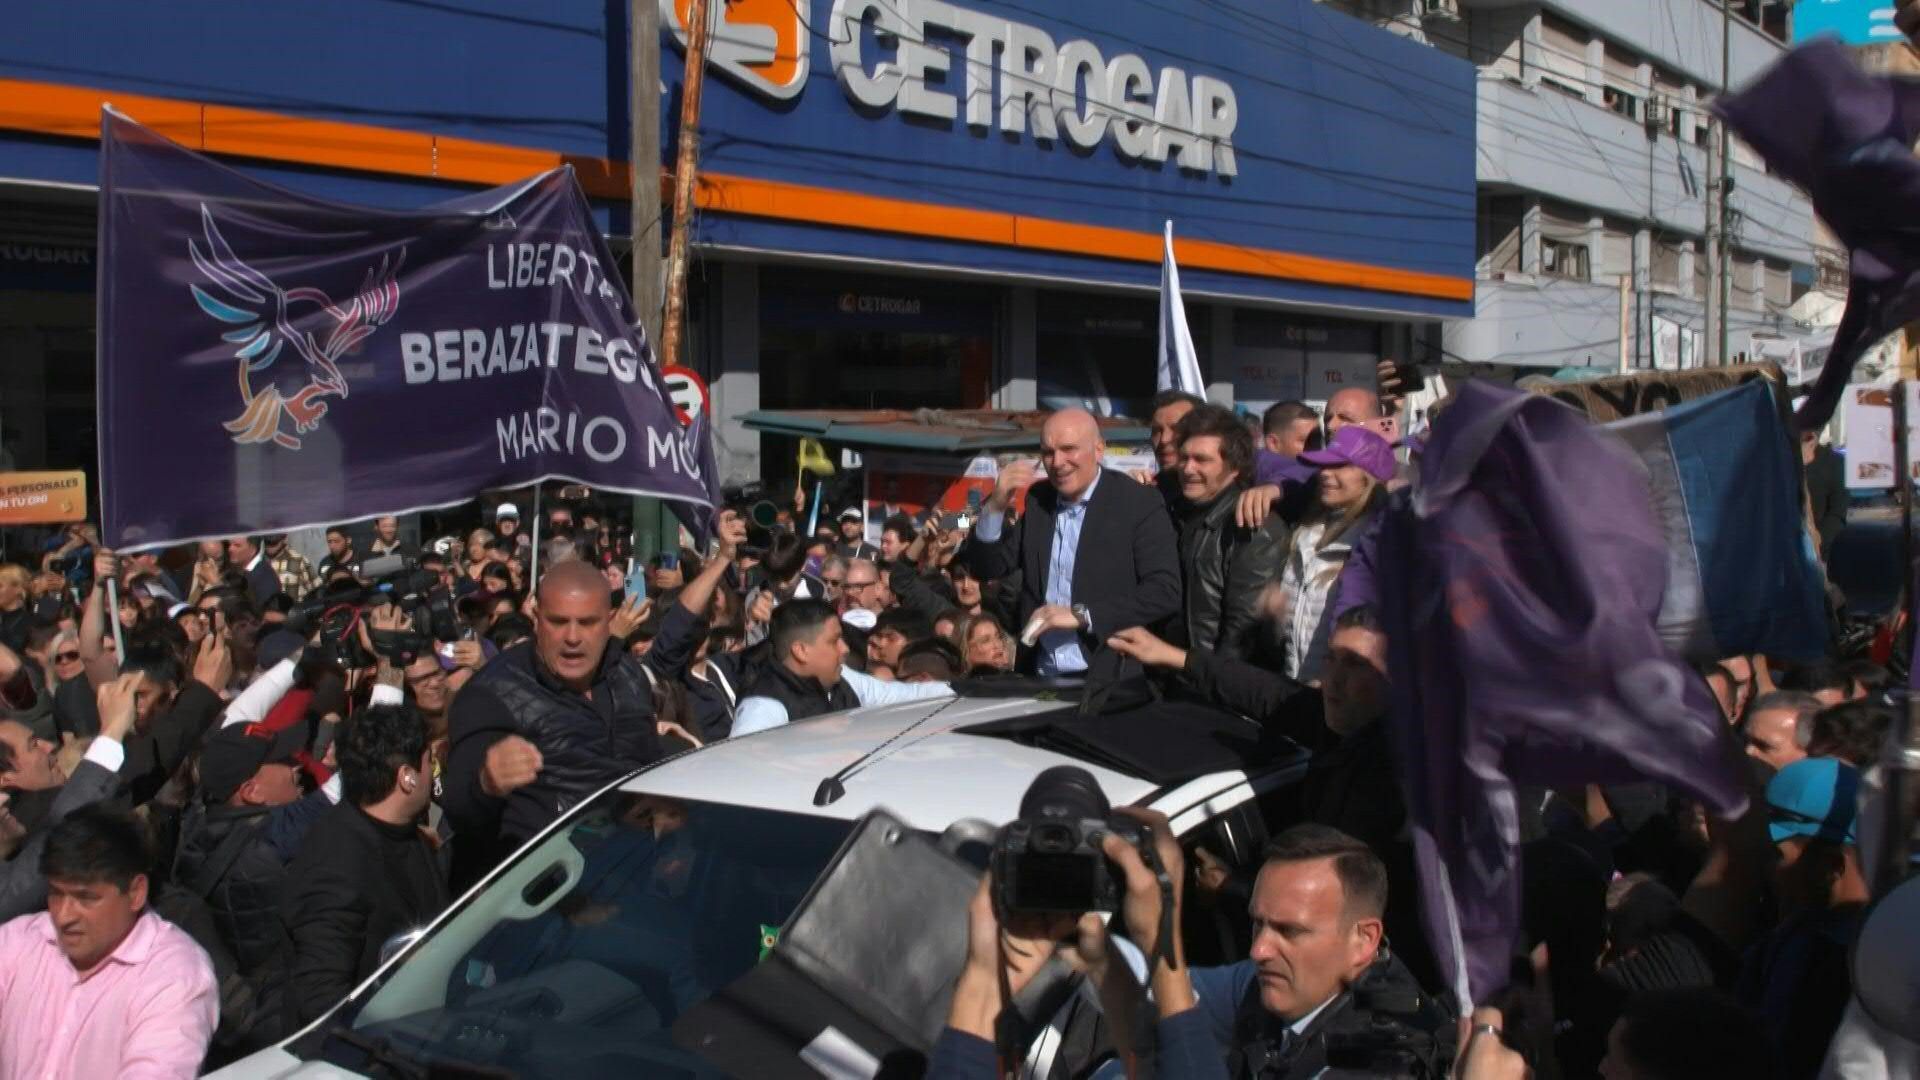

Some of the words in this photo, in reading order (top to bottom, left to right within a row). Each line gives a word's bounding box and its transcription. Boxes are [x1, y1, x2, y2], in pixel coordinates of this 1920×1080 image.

[829, 0, 1239, 176] CETROGAR
[858, 296, 921, 314] CETROGAR
[496, 406, 626, 463] MARIO
[7, 477, 79, 496] PERSONALES
[12, 497, 25, 508] TU
